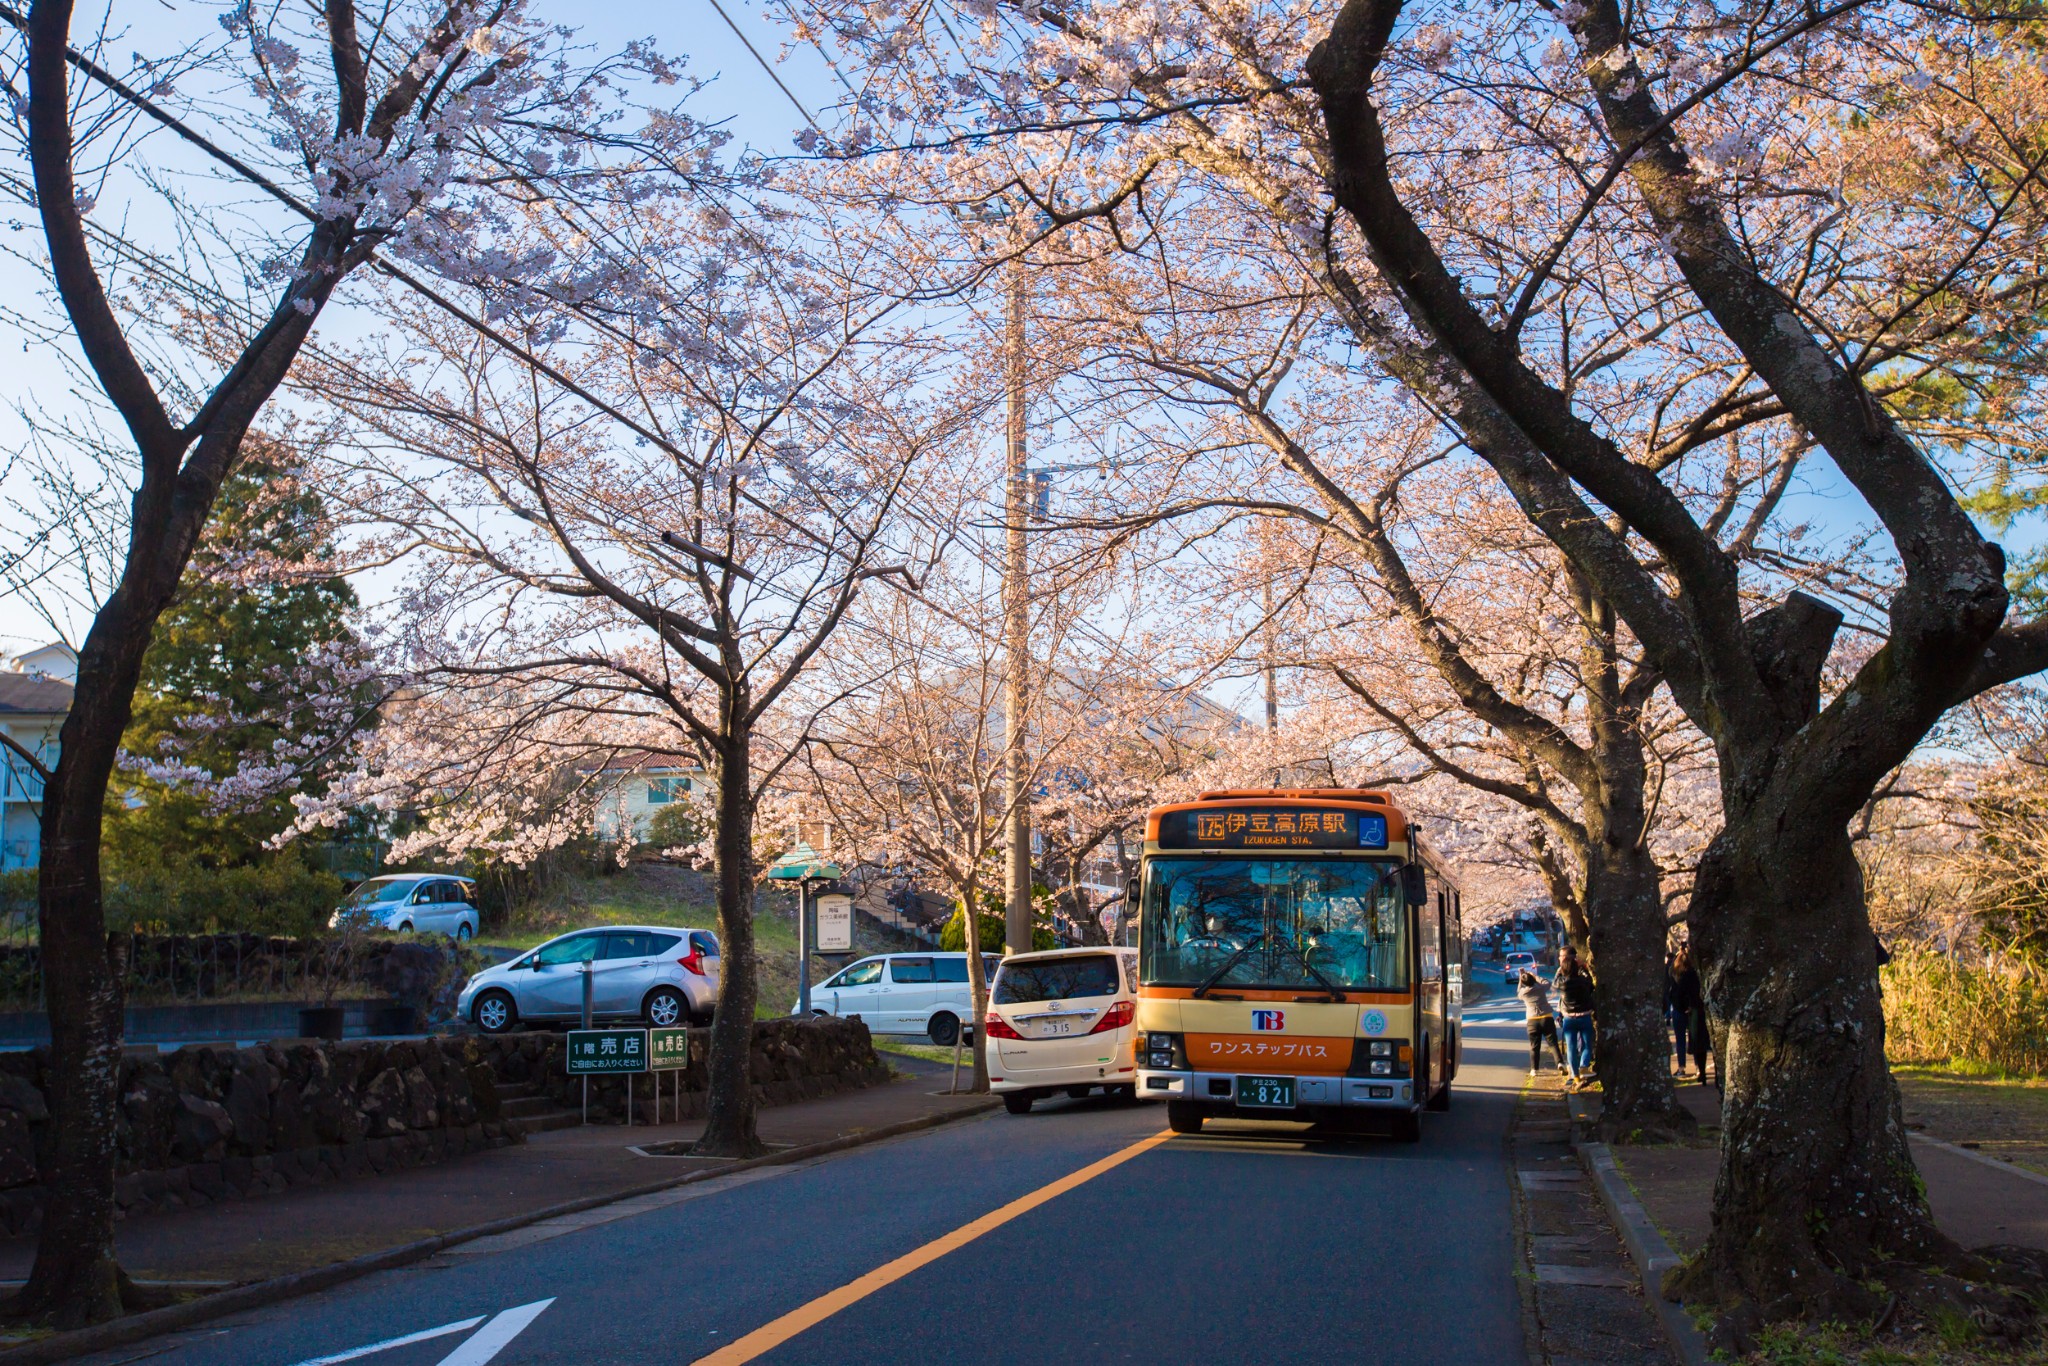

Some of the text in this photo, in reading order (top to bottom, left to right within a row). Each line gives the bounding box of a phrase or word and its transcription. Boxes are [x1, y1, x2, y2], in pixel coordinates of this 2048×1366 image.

[1200, 817, 1223, 837] 175
[1225, 813, 1347, 833] 伊豆高原駅
[1252, 1010, 1285, 1031] TB
[1210, 1042, 1328, 1058] ワンステップバス
[571, 1058, 643, 1069] ご自由にお入りください
